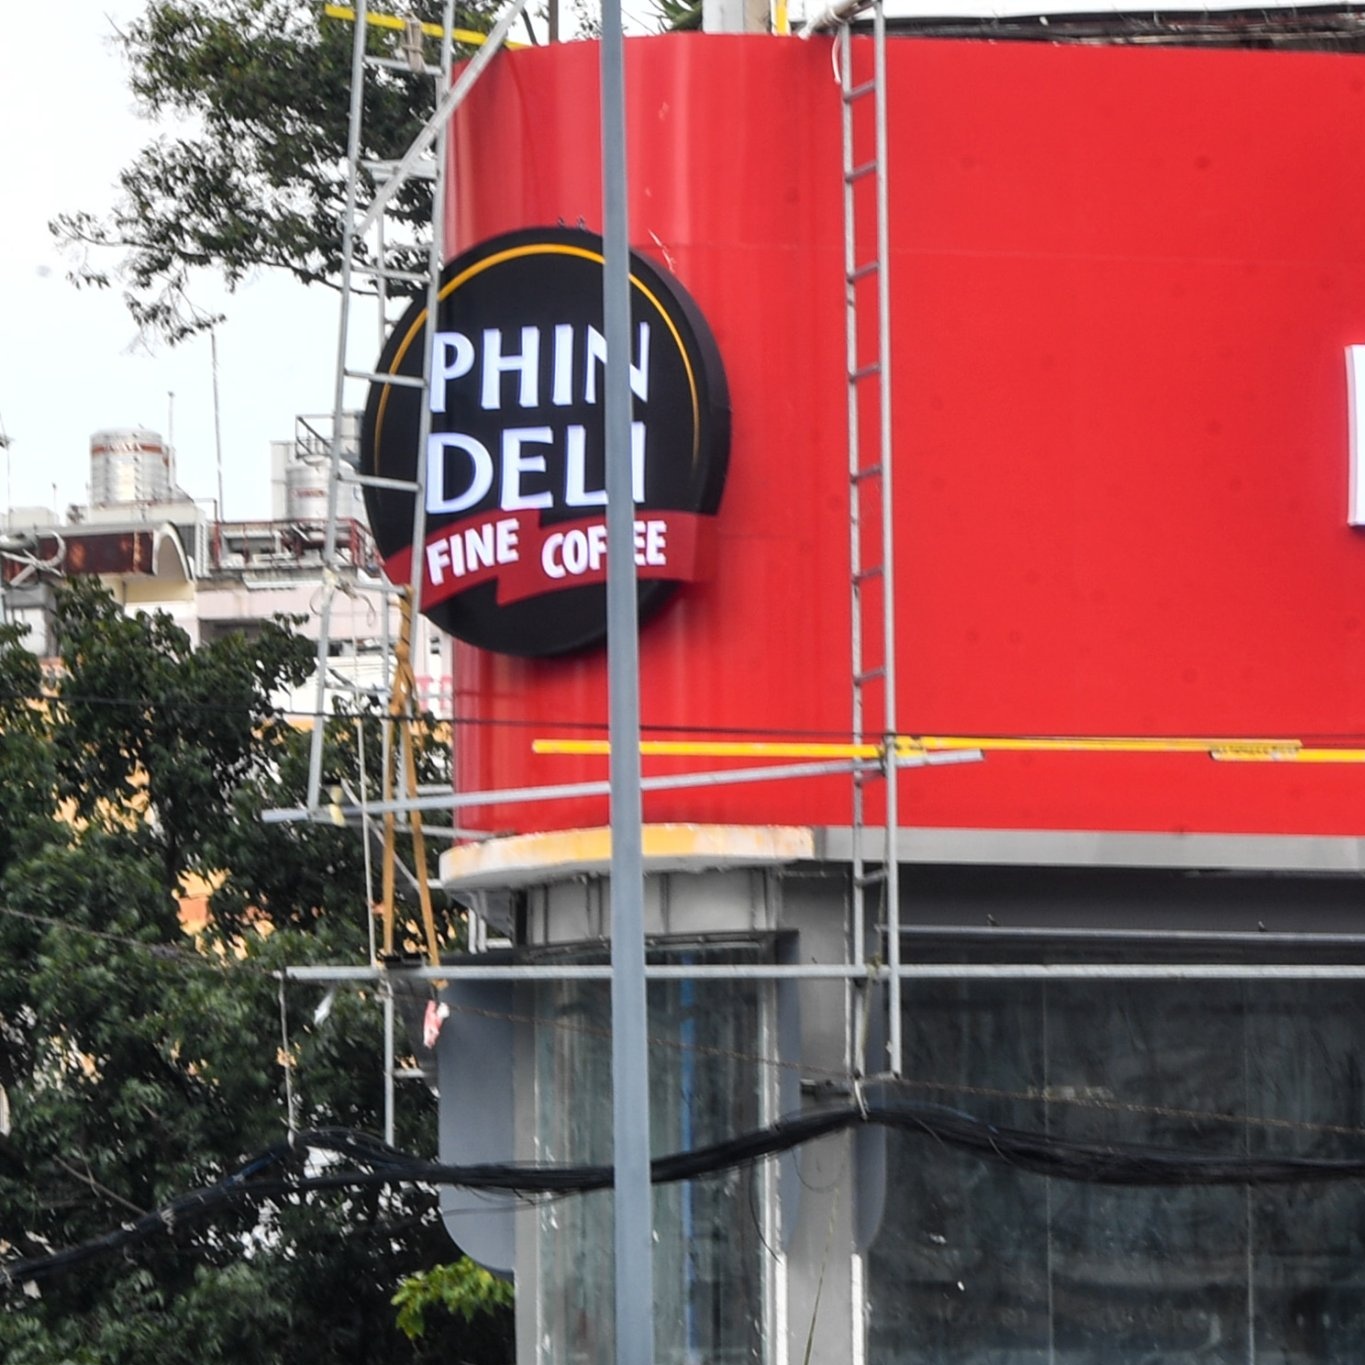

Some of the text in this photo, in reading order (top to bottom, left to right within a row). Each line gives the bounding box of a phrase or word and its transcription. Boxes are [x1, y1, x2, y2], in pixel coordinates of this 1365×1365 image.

[429, 321, 650, 413] PHIN
[425, 421, 647, 514] DELI
[426, 517, 667, 586] FINE COFEE
